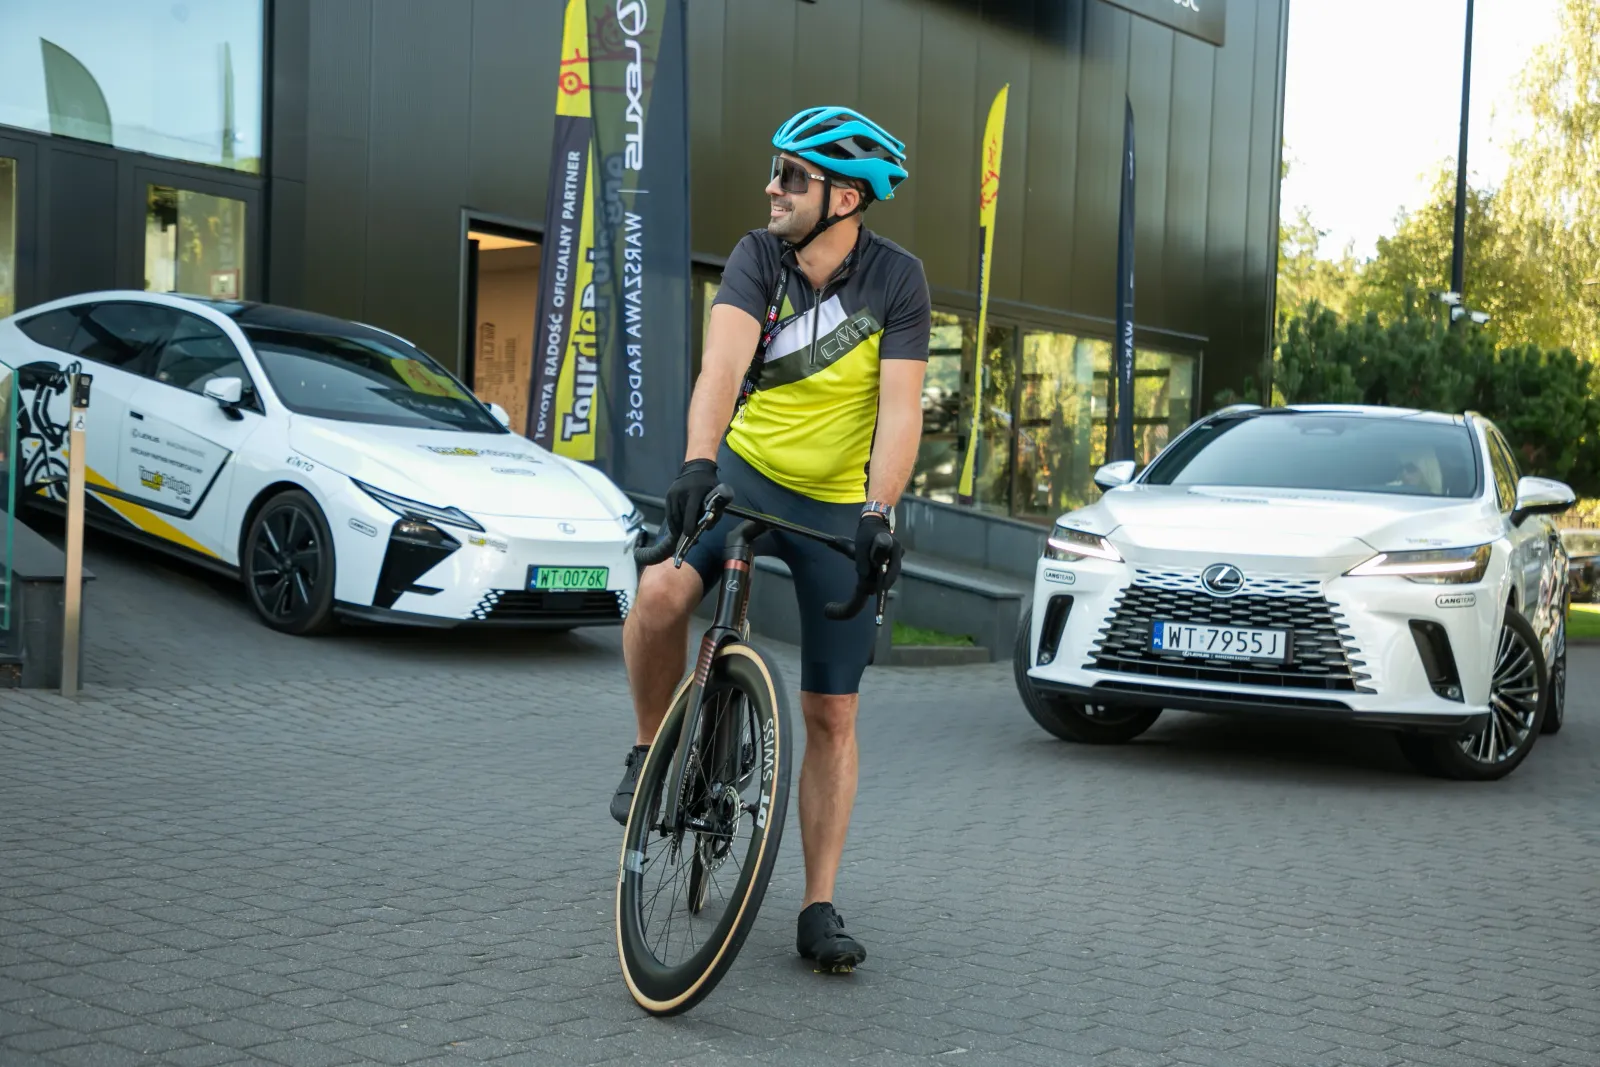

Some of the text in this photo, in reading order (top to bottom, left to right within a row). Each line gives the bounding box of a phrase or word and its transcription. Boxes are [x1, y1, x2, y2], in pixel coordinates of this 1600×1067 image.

[534, 151, 580, 440] TOYOTA RADOŚĆ OFICJALNY PARTNER
[821, 317, 871, 359] CMP
[541, 570, 559, 586] WT
[563, 570, 605, 587] 0076K
[1045, 572, 1074, 581] LANGTEAM
[1439, 596, 1475, 605] LANGTEAM
[1169, 626, 1277, 656] WT 7955J
[757, 718, 774, 828] DT SWISS
